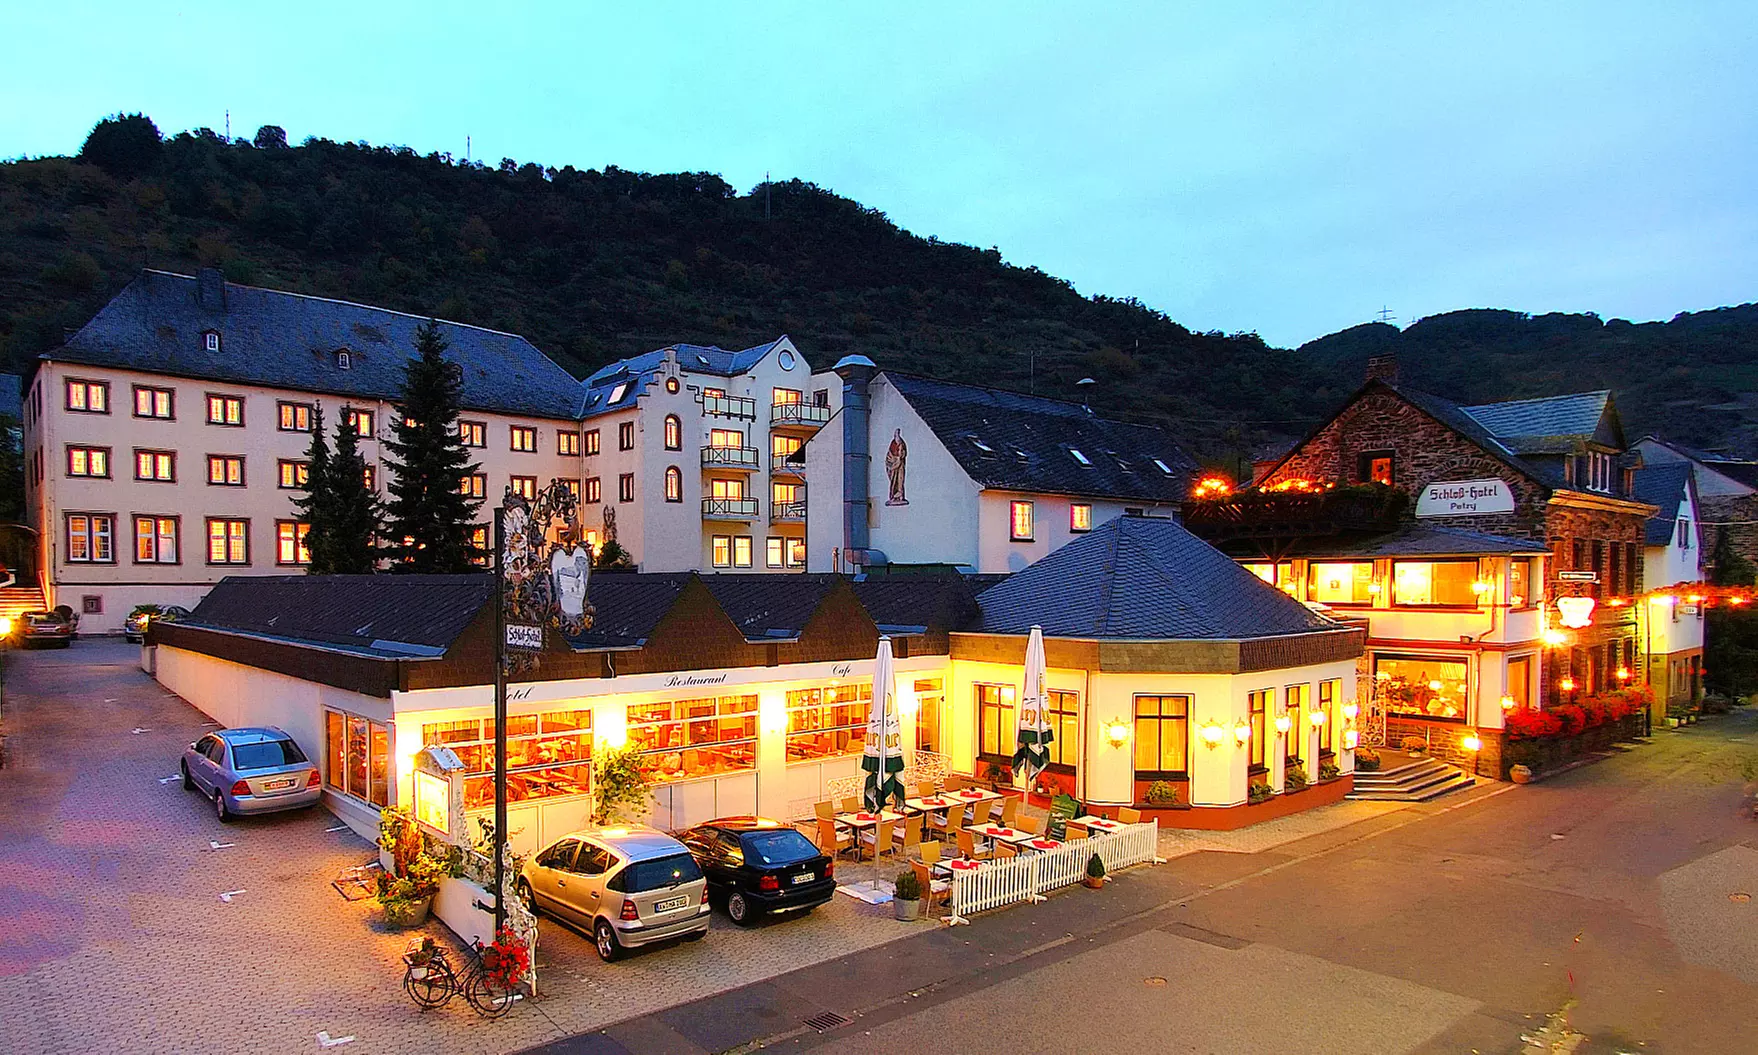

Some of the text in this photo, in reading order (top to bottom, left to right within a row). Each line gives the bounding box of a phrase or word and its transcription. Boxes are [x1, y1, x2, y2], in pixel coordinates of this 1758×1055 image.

[1430, 485, 1498, 501] Schloß-Hotel
[1450, 502, 1477, 511] Petry
[664, 673, 727, 687] Restaurant
